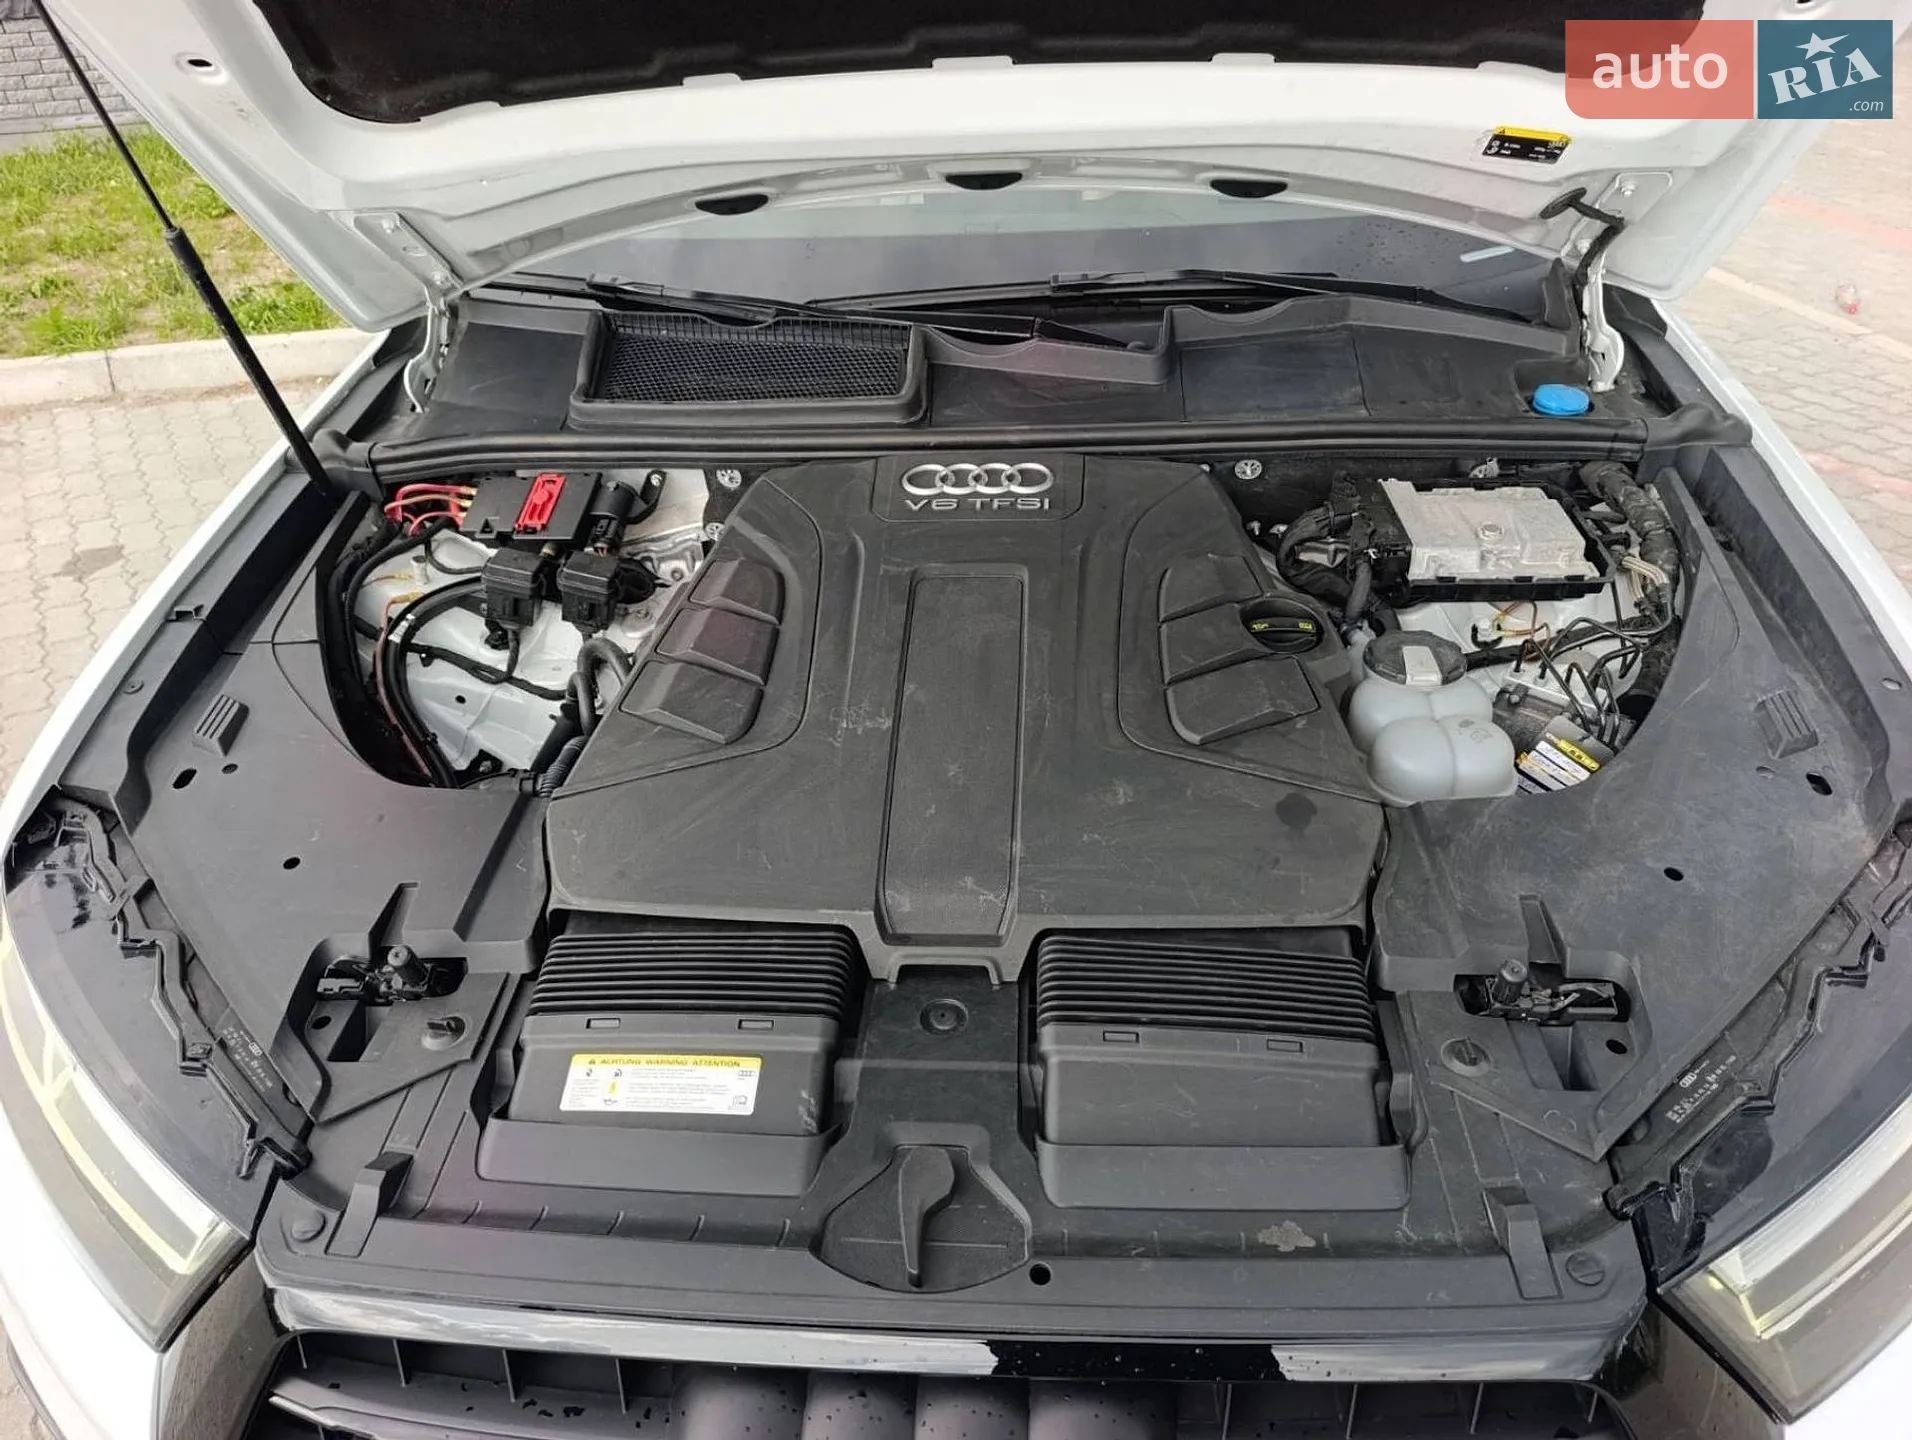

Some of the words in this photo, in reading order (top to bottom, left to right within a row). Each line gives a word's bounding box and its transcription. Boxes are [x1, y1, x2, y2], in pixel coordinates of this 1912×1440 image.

[904, 497, 959, 511] V6
[967, 497, 1050, 511] TFSI
[646, 1058, 689, 1067] WARNING
[692, 1058, 741, 1068] ATTENTION
